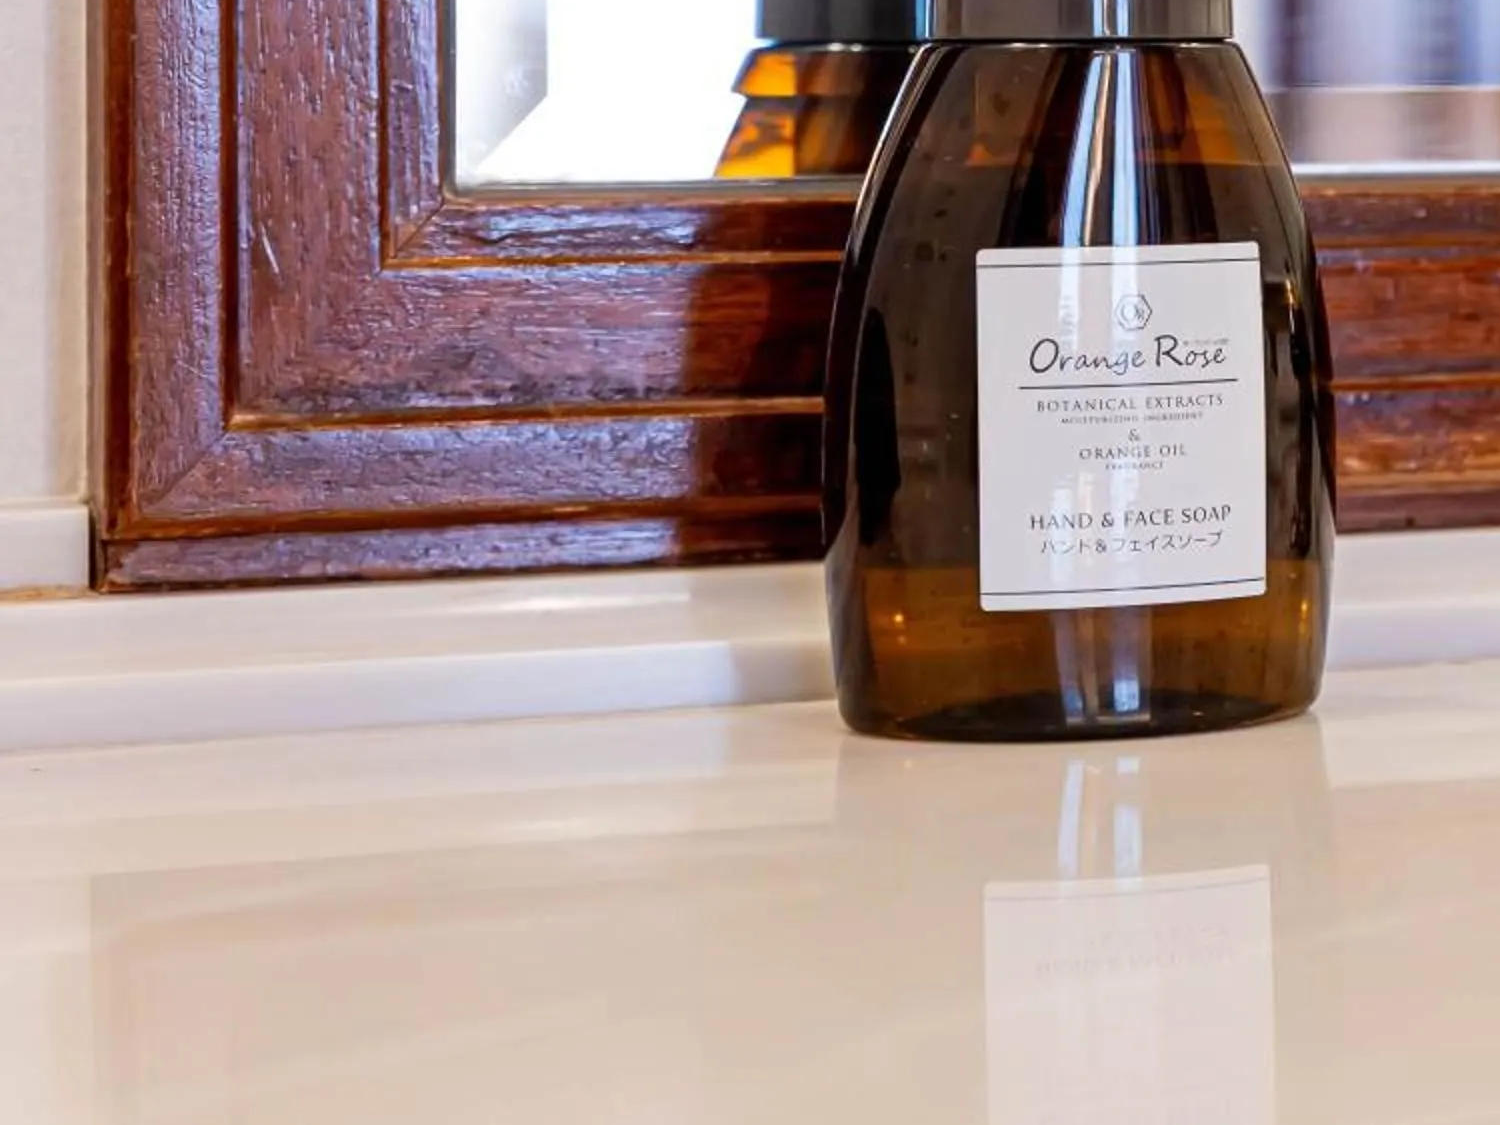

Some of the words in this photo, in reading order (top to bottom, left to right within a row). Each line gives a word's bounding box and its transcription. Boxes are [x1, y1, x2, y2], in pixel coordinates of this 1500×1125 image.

[1029, 337, 1145, 375] Orange
[1154, 334, 1226, 369] Rose
[1036, 398, 1137, 413] BOTANICAL
[1145, 393, 1224, 409] EXTRACTS
[1127, 428, 1141, 442] &
[1079, 445, 1150, 460] ORANGE
[1159, 444, 1188, 458] OIL
[1030, 512, 1094, 531] HAND
[1101, 512, 1115, 529] &
[1123, 508, 1175, 528] FACE
[1181, 503, 1232, 524] SOAP
